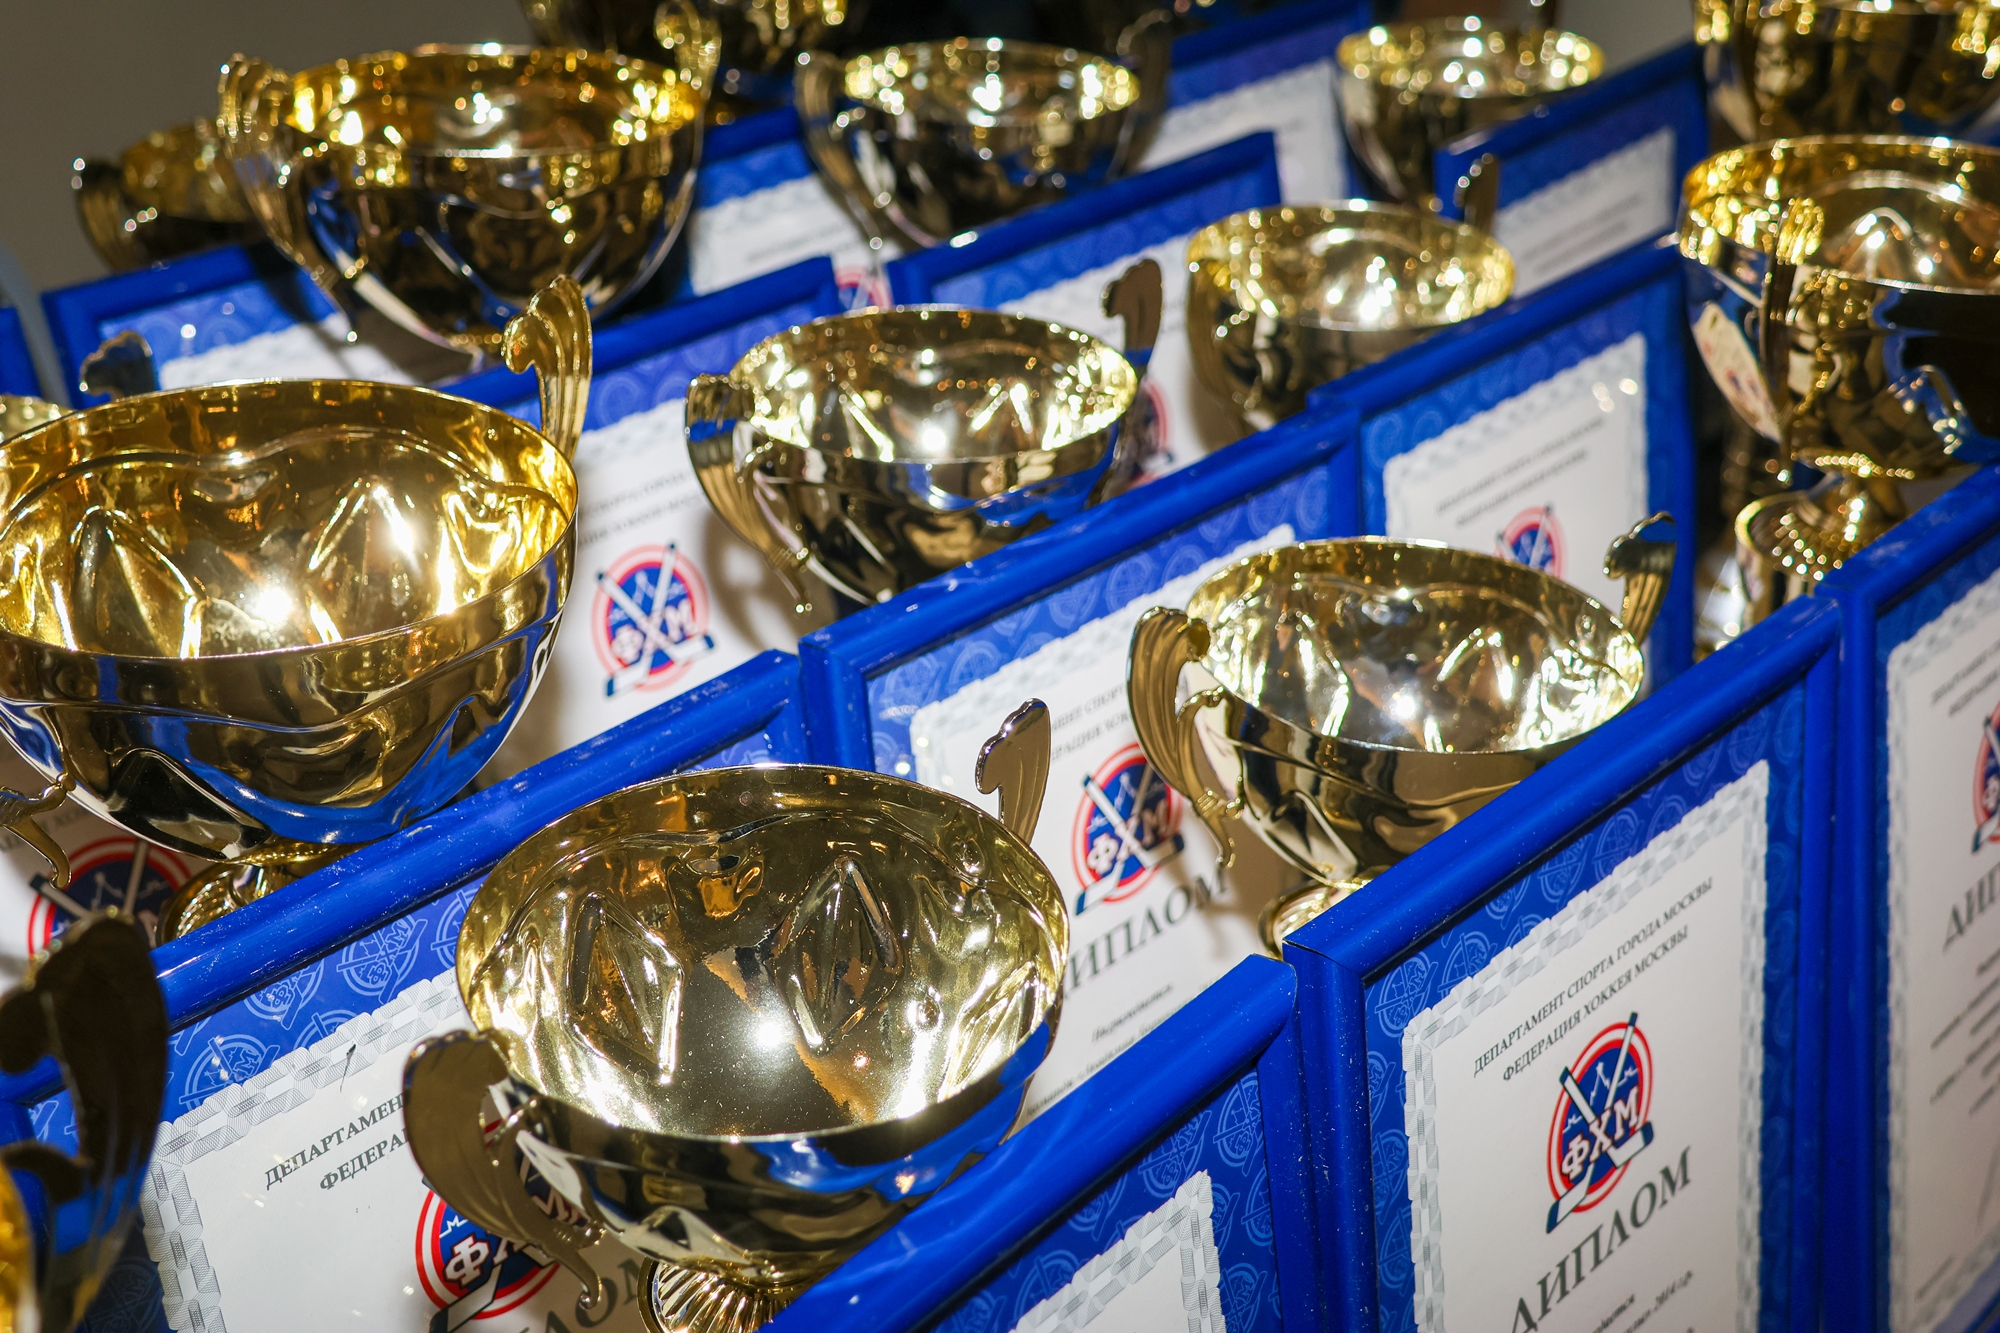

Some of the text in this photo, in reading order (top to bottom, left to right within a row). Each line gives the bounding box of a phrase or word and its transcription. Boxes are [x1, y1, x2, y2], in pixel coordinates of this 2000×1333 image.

[1066, 868, 1227, 998] ИПЛОМ
[1474, 877, 1713, 1077] ДЕПАРТАМЕНТ СПОРТА ГОРОДА МОСКВЫ
[1503, 925, 1689, 1081] ФЕДЕРАЦИЯ ХОККЕЯ МОСКВЫ
[265, 1093, 404, 1190] ДЕПАРТАМЕН
[320, 1128, 408, 1190] ФЕДЕРА
[1561, 1084, 1640, 1182] ФХМ
[1511, 1145, 1691, 1333] ДИПЛОМ
